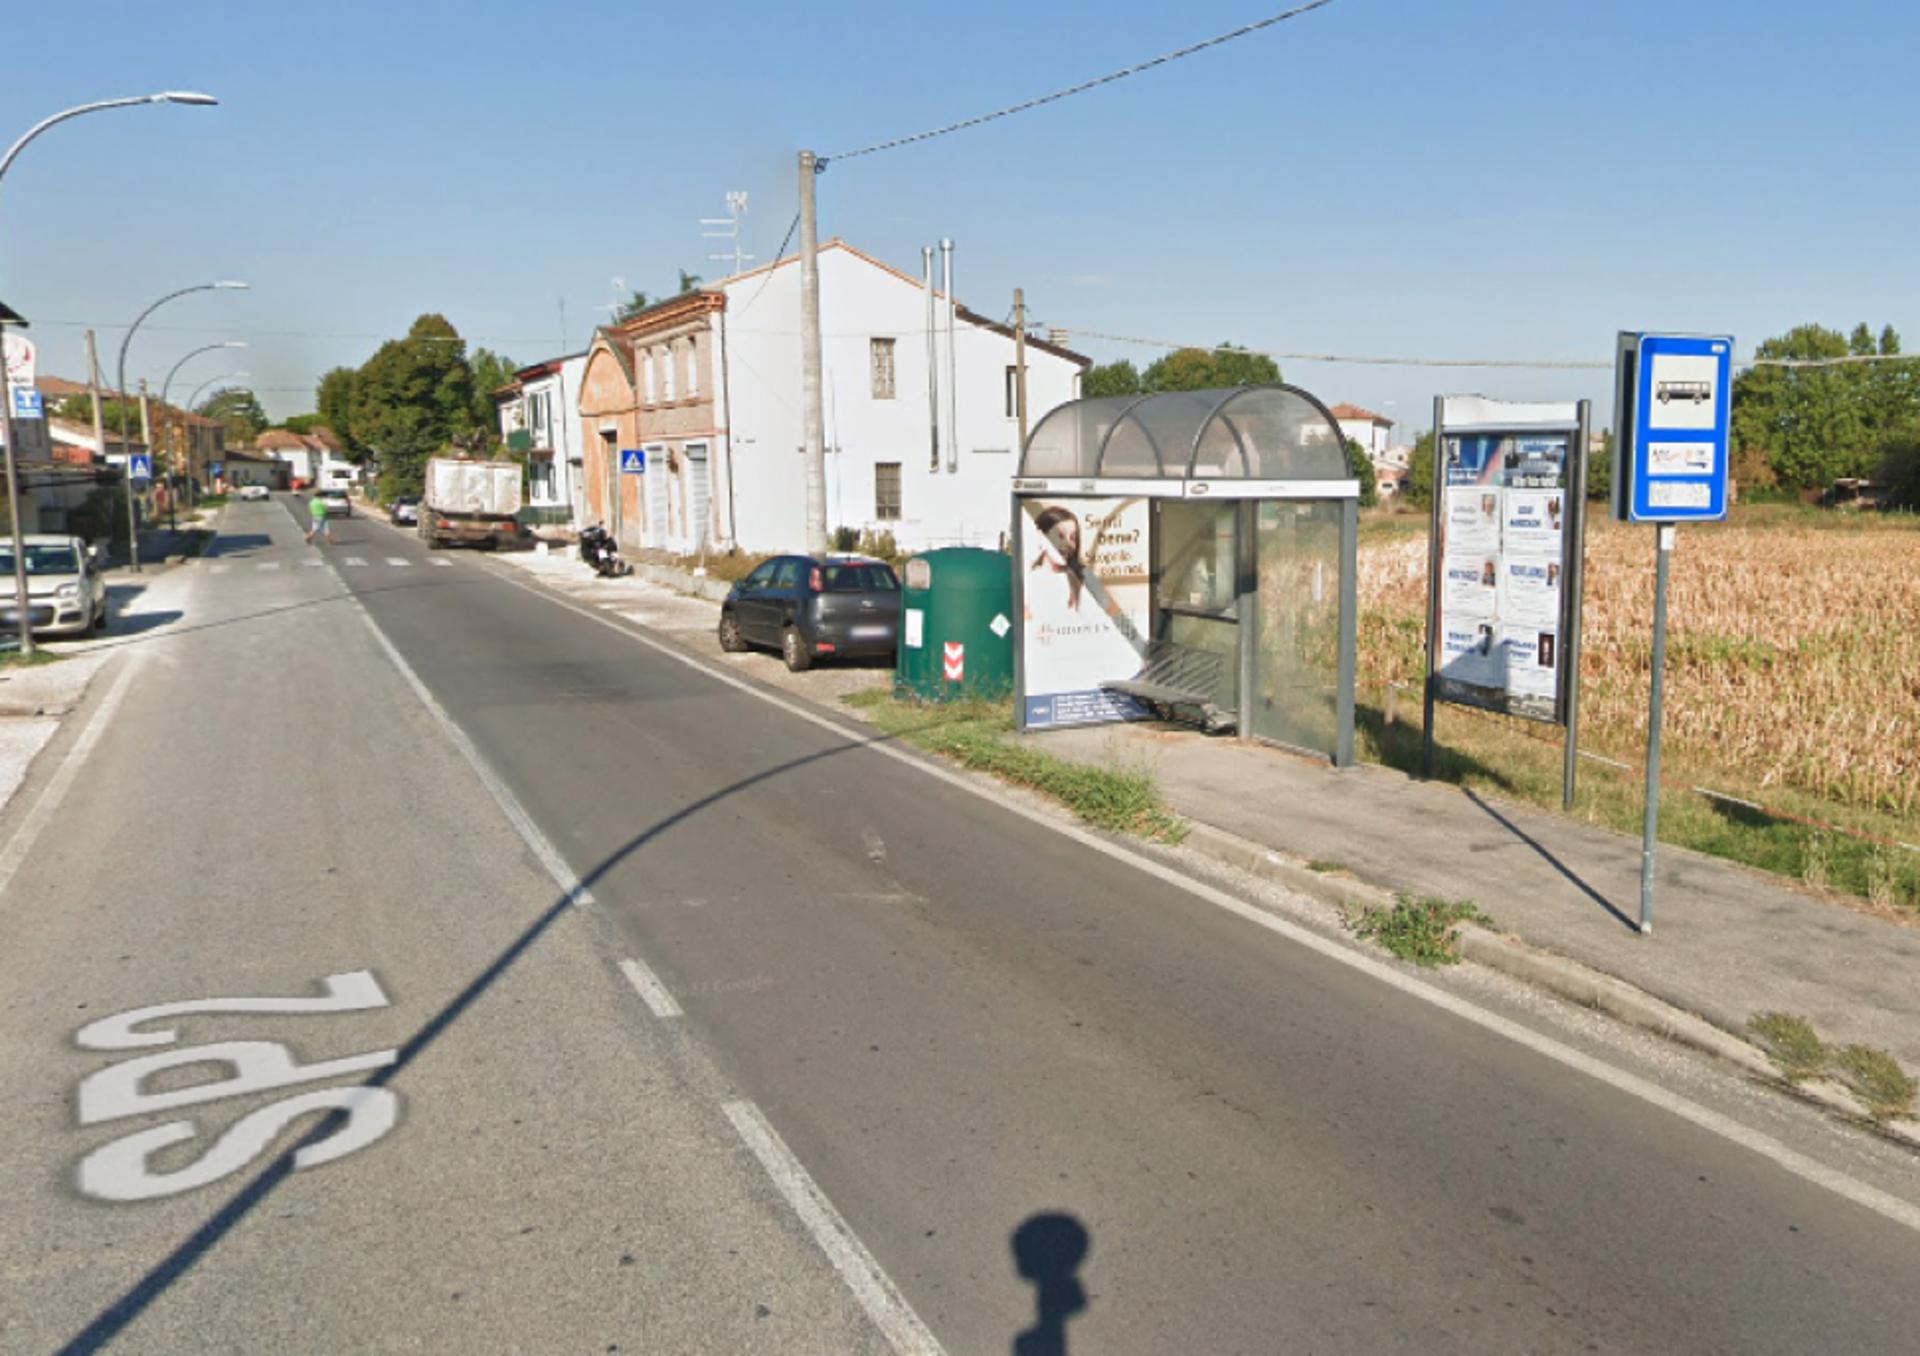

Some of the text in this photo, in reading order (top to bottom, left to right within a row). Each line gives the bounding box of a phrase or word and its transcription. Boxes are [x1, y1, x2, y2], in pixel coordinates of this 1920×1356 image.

[1097, 529, 1140, 544] bene?
[1101, 566, 1122, 576] con
[77, 970, 401, 1201] SP2
